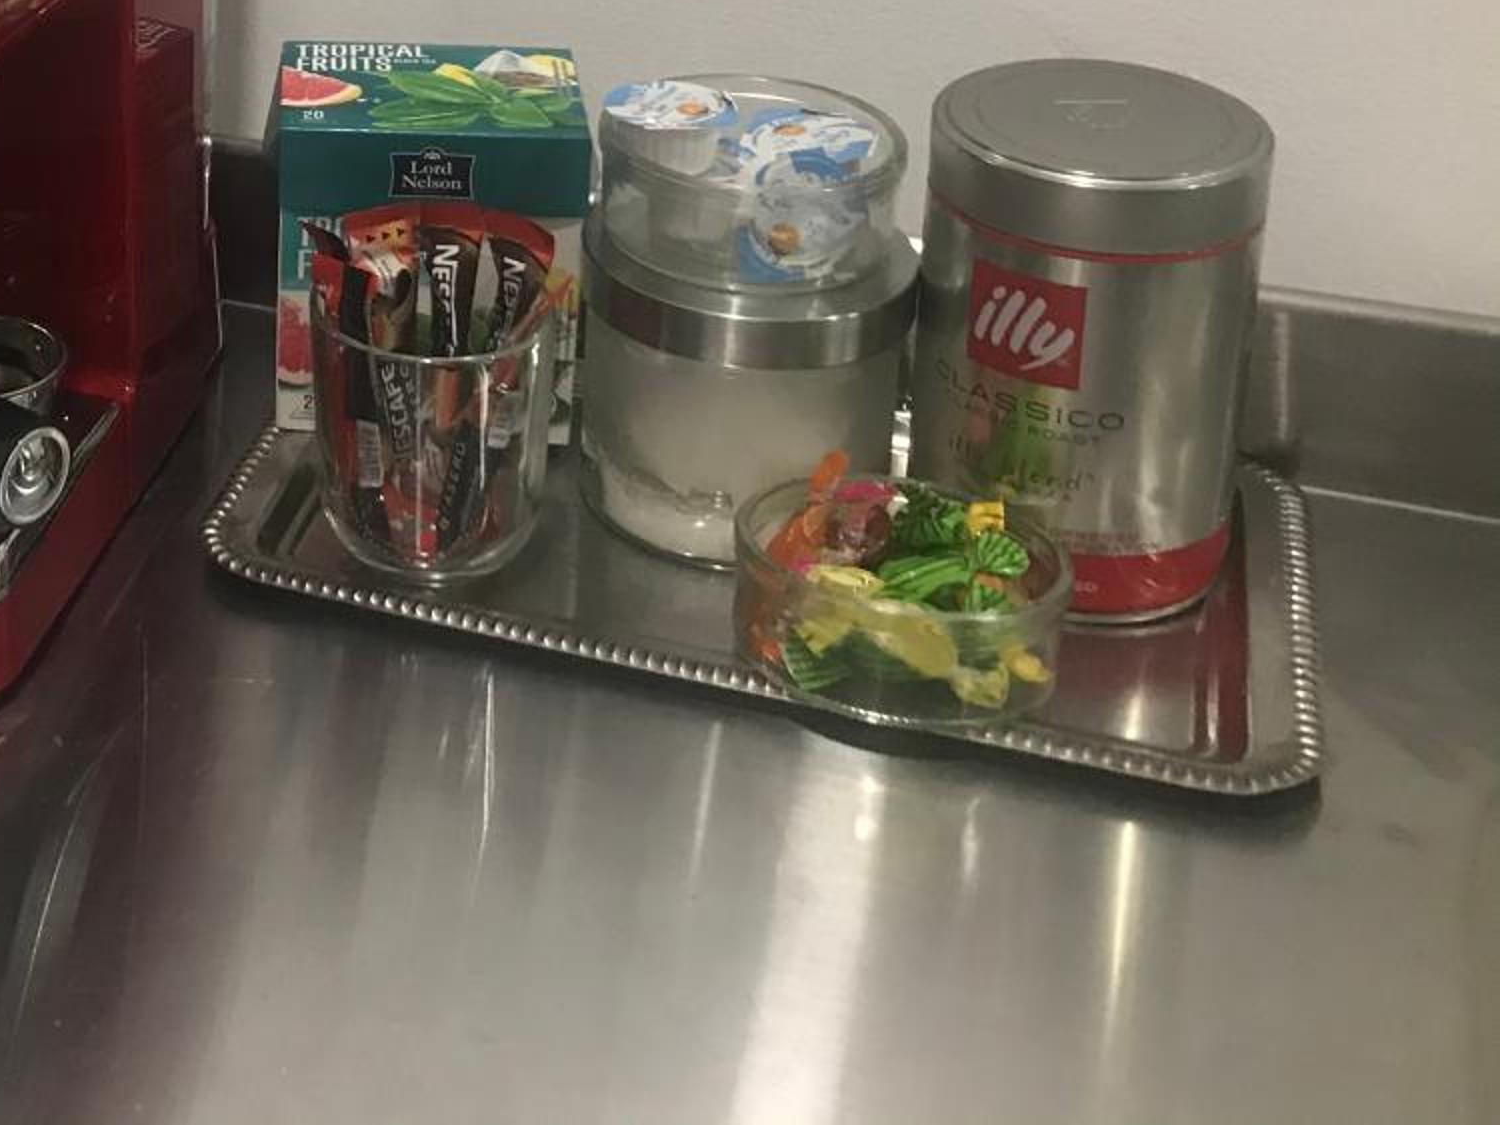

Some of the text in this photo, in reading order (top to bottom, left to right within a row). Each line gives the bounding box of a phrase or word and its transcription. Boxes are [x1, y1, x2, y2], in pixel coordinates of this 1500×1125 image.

[296, 44, 430, 58] TROPICAL
[296, 57, 392, 72] FRUITS
[303, 109, 325, 121] 20
[411, 161, 453, 175] Lord
[402, 175, 462, 190] Nelson
[974, 285, 1076, 372] illy
[936, 359, 1125, 431] CLASSICO
